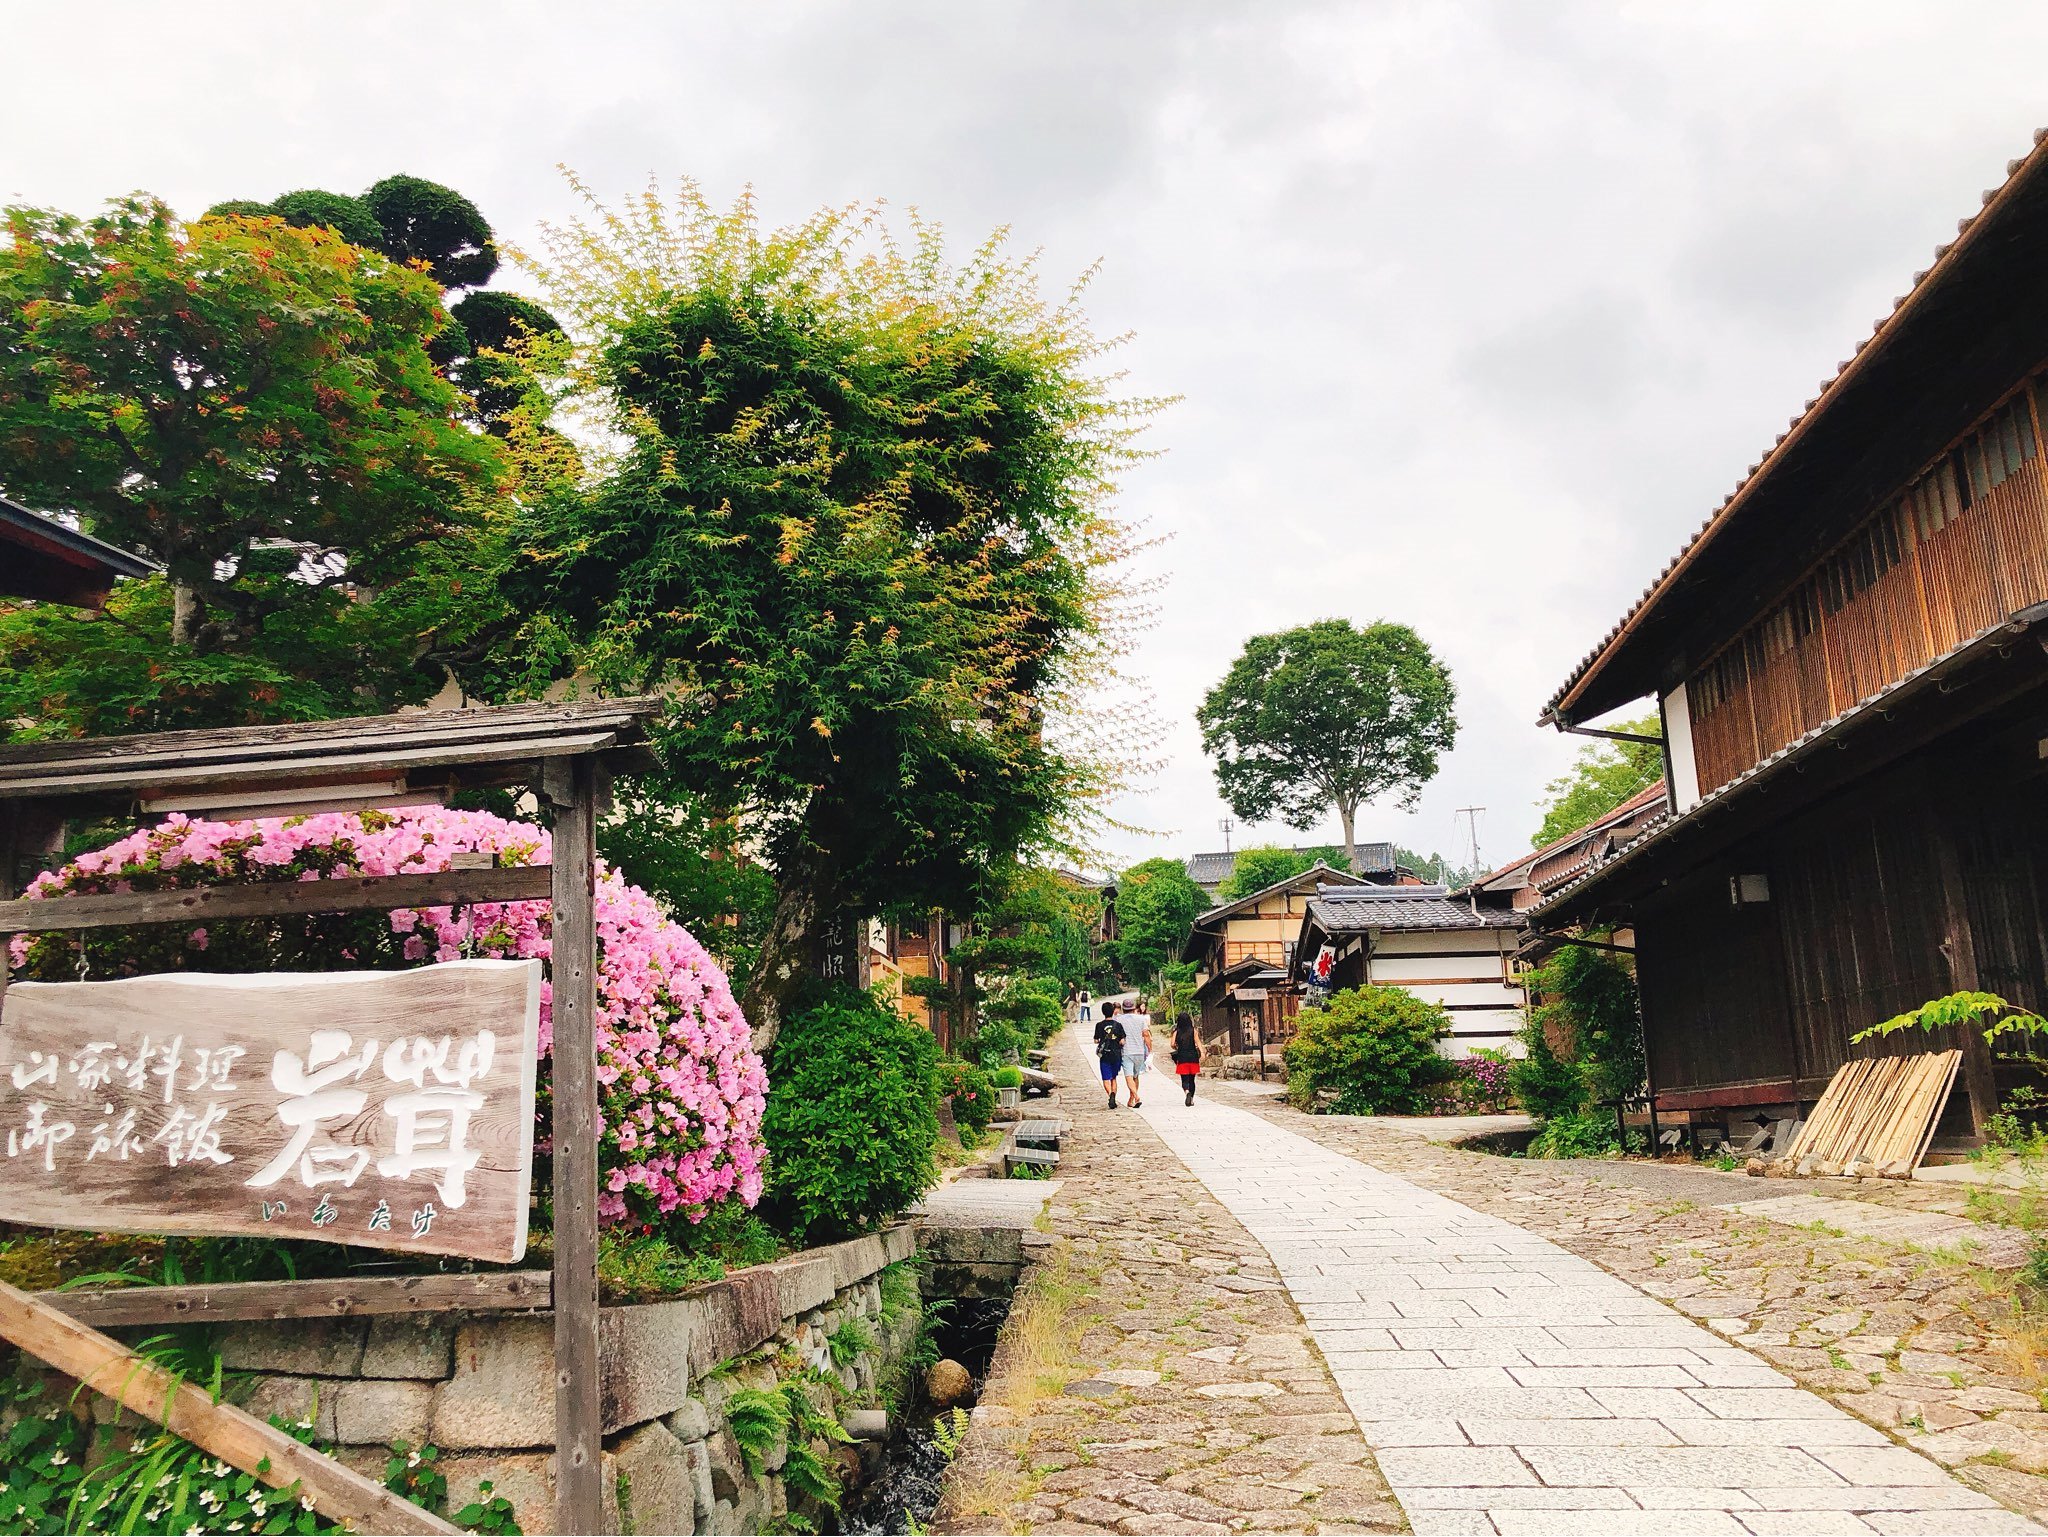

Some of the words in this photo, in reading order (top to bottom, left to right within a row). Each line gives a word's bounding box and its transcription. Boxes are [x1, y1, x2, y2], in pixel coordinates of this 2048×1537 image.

[1317, 951, 1333, 978] 氷
[12, 1034, 246, 1103] 山家料理
[244, 1028, 495, 1209] 岩茸
[262, 1192, 437, 1240] いわたけ
